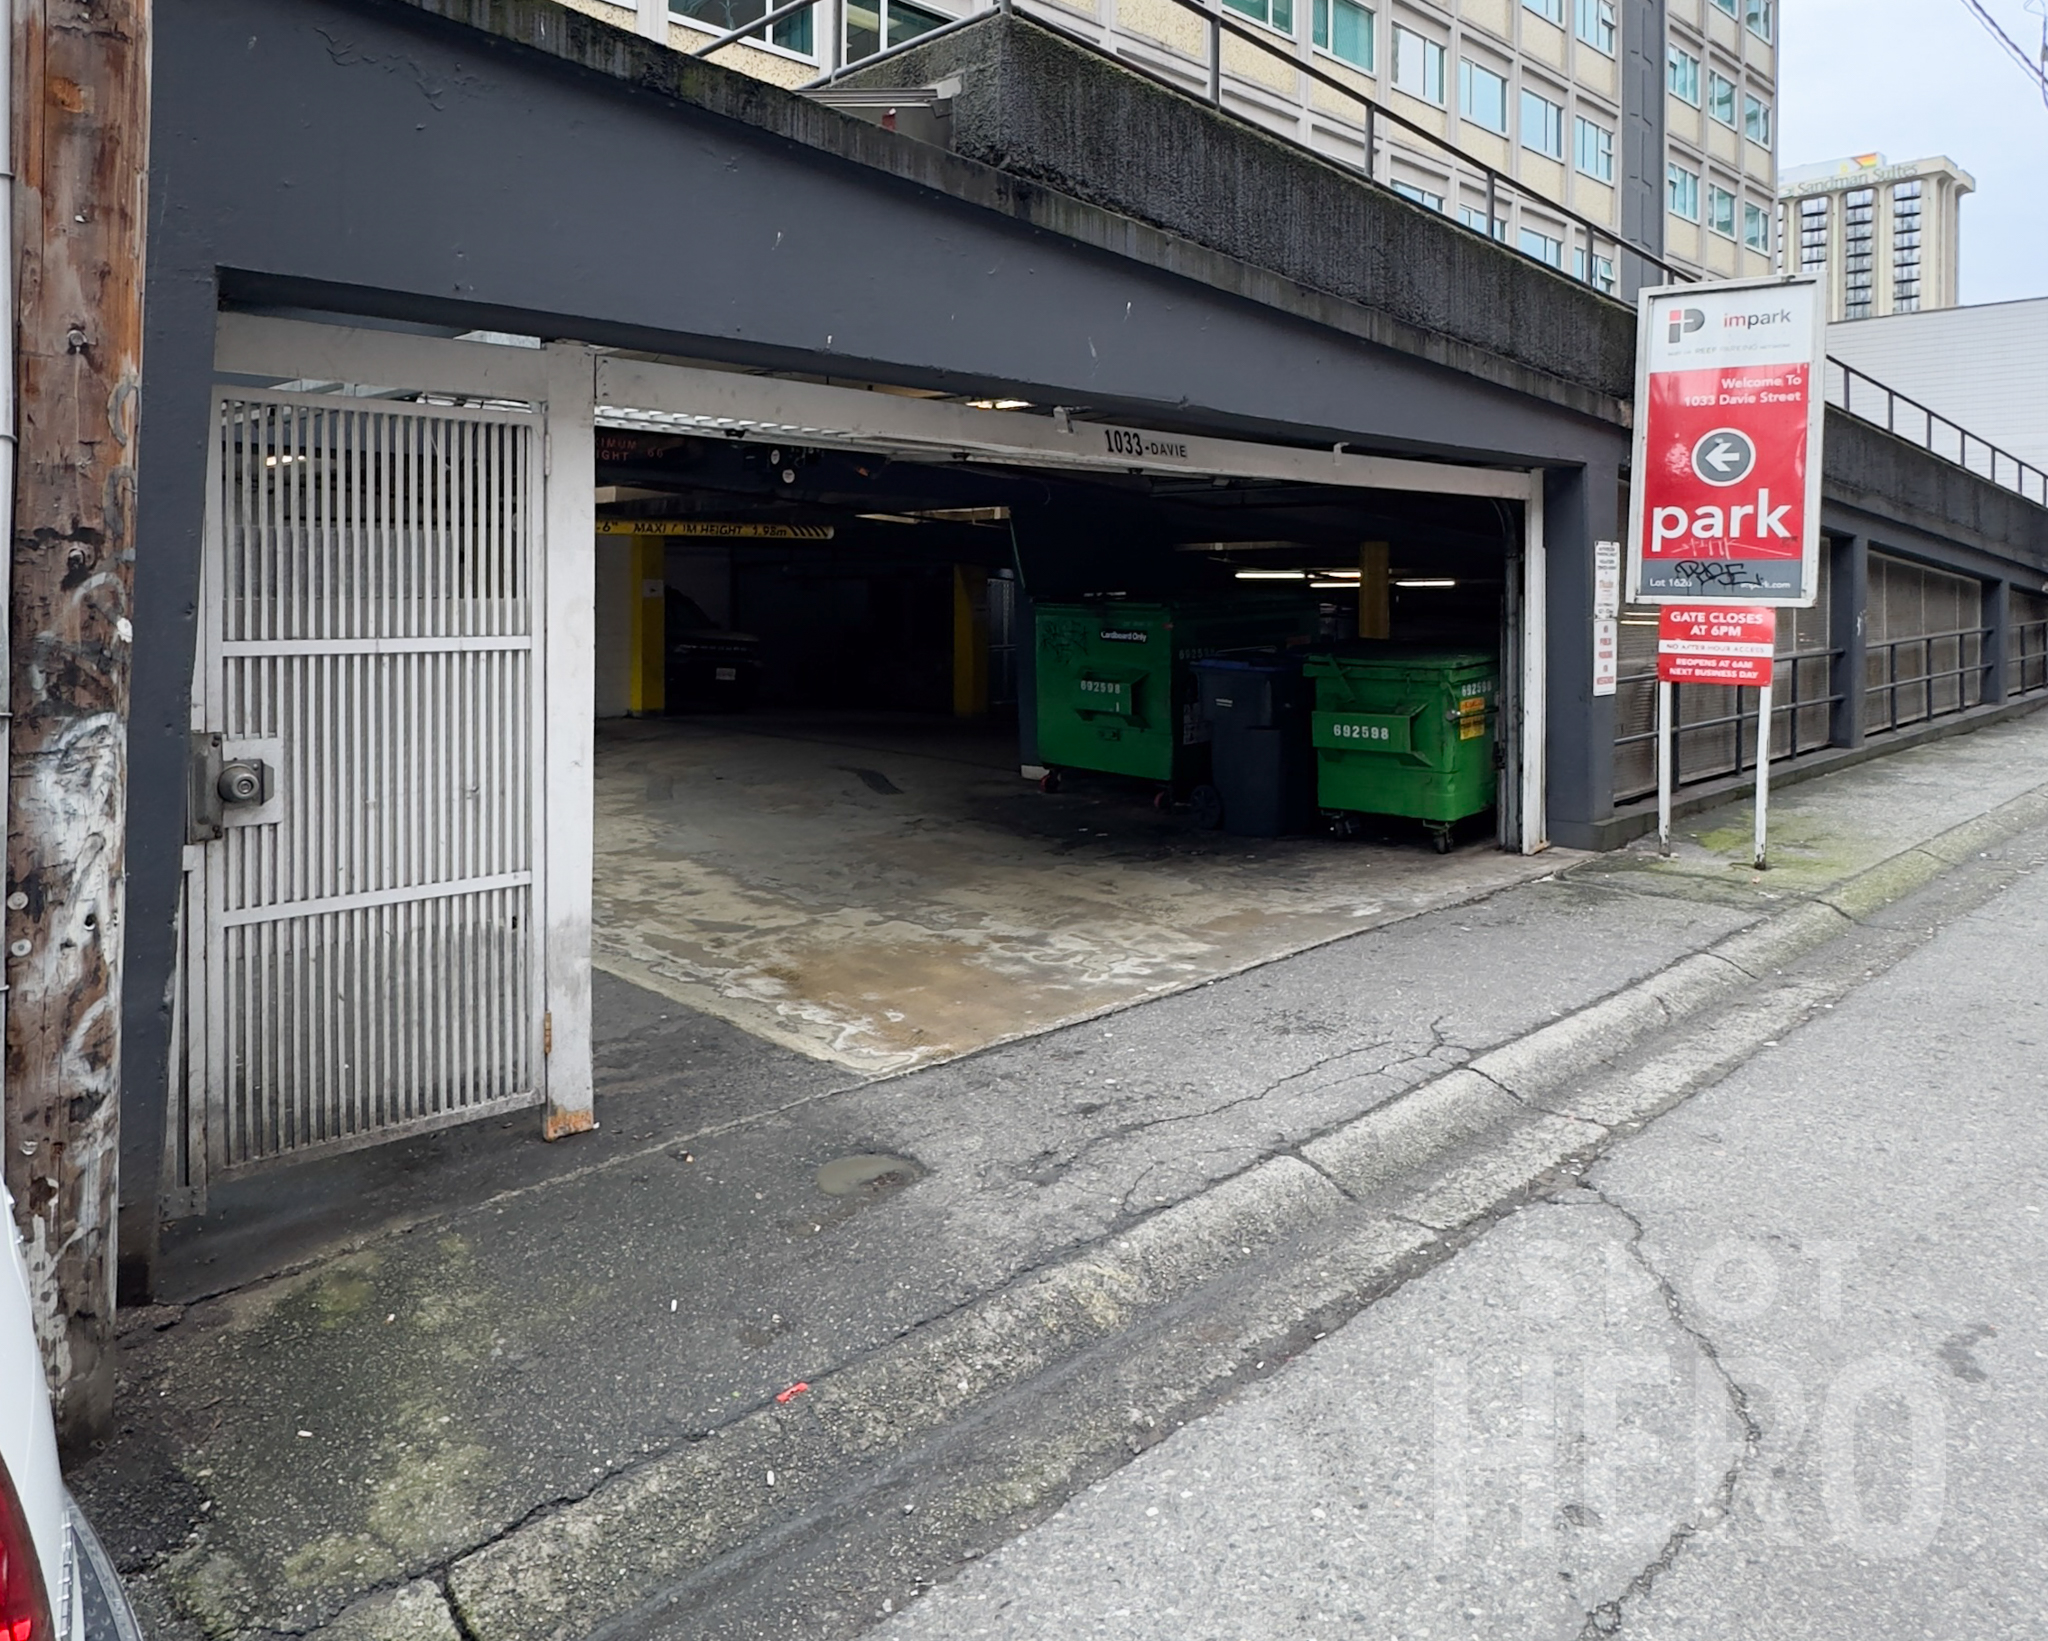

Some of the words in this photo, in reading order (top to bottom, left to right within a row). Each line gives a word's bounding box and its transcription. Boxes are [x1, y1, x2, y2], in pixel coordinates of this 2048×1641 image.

[1797, 174, 1868, 195] Sandman
[1873, 163, 1918, 182] Suites
[1723, 309, 1792, 330] impark
[1721, 377, 1783, 389] Welcome
[1785, 374, 1802, 385] To
[1684, 395, 1716, 407] 1033
[1719, 393, 1757, 405] Davie
[1760, 391, 1802, 403] Street
[1651, 488, 1792, 553] park
[699, 524, 743, 535] HEIGHT
[1649, 578, 1661, 587] Lot
[1670, 611, 1706, 623] GATE
[1709, 612, 1763, 624] CLOSES
[1132, 632, 1148, 643] Only
[1690, 625, 1709, 636] AT
[1710, 625, 1742, 637] 6PM
[1675, 658, 1717, 668] REOPENS
[1718, 660, 1731, 668] AT
[1731, 660, 1754, 669] 6AM
[1669, 667, 1693, 676] NEXT
[1694, 668, 1738, 678] BUSINESS
[1739, 671, 1759, 679] DAY
[1080, 680, 1121, 695] 692598
[1332, 723, 1390, 741] 692598
